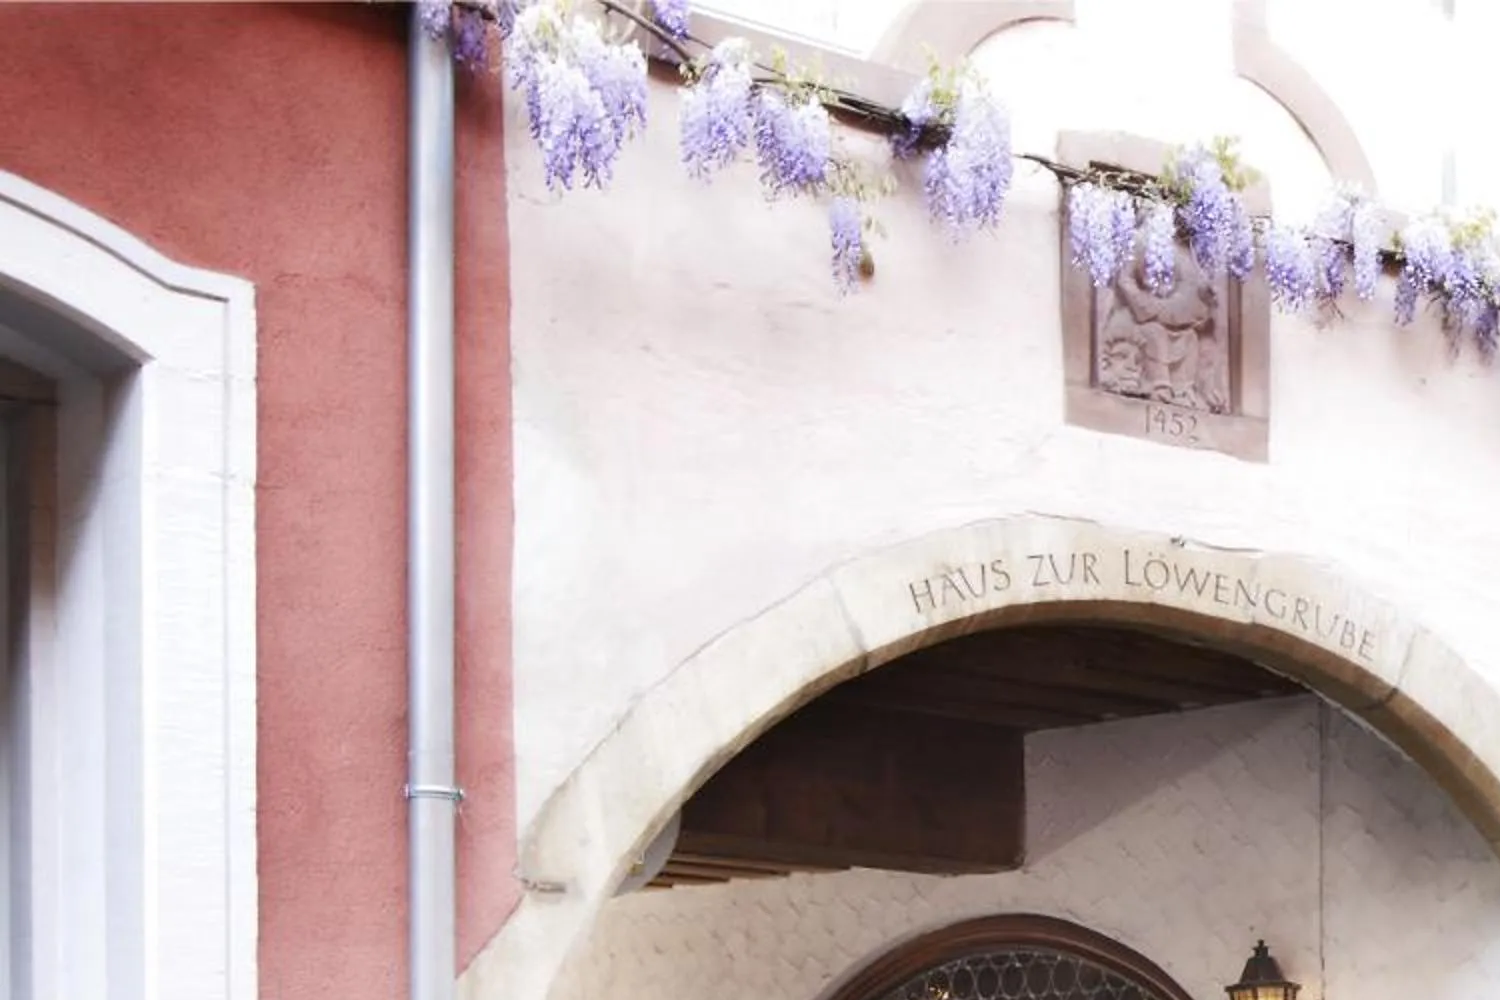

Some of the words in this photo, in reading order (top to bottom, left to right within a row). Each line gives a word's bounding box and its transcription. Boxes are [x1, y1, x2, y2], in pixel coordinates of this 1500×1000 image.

[908, 557, 1012, 614] HAUS
[1026, 552, 1101, 588] ZUR
[1123, 548, 1376, 662] LÖWENGRUBE
